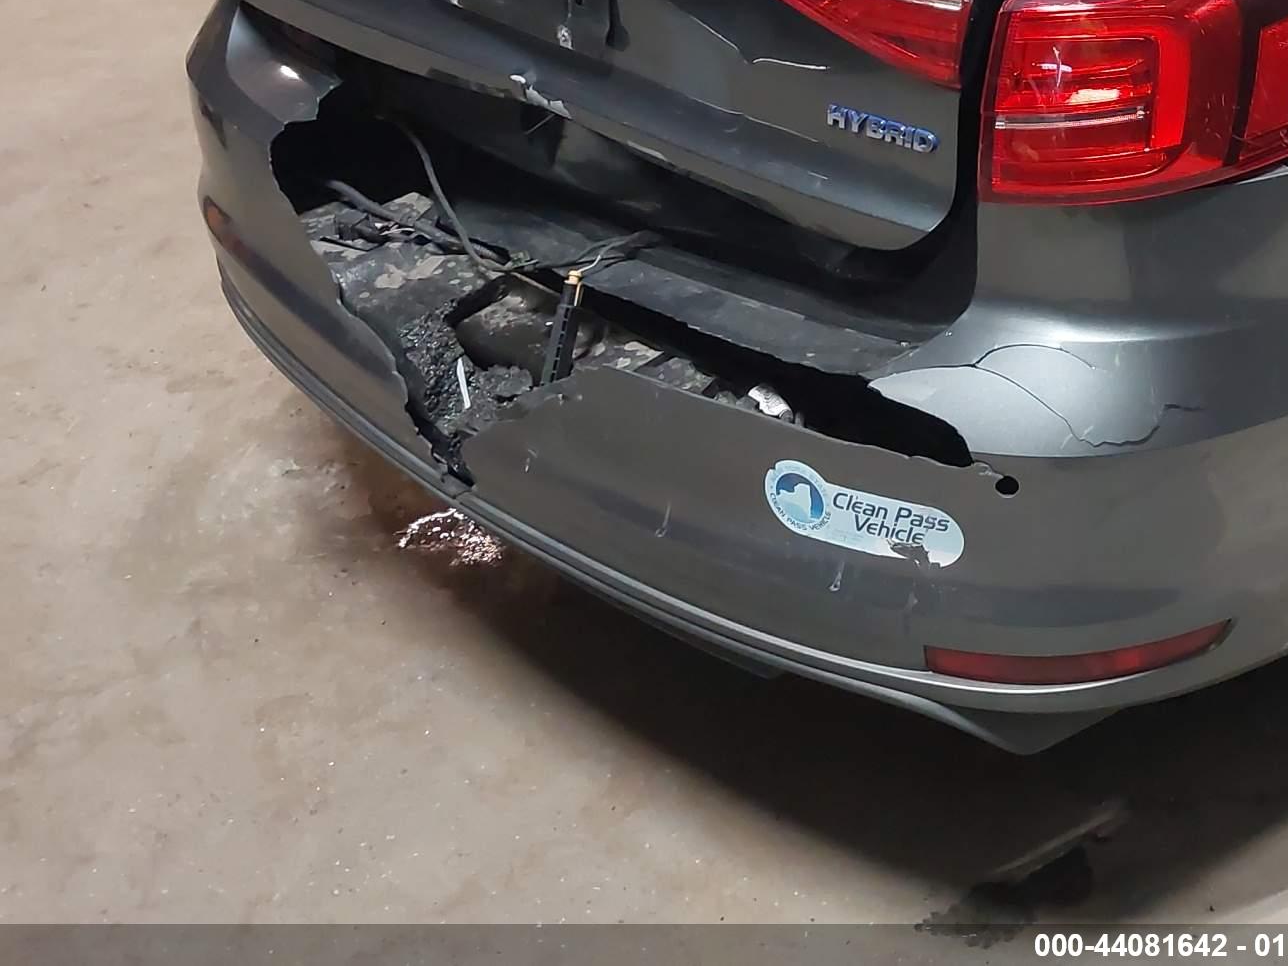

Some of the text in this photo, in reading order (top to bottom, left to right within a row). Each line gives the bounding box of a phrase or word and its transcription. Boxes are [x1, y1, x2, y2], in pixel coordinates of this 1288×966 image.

[826, 103, 941, 153] HYBRID
[832, 491, 950, 532] Clean Pass
[854, 513, 925, 544] Vehicle
